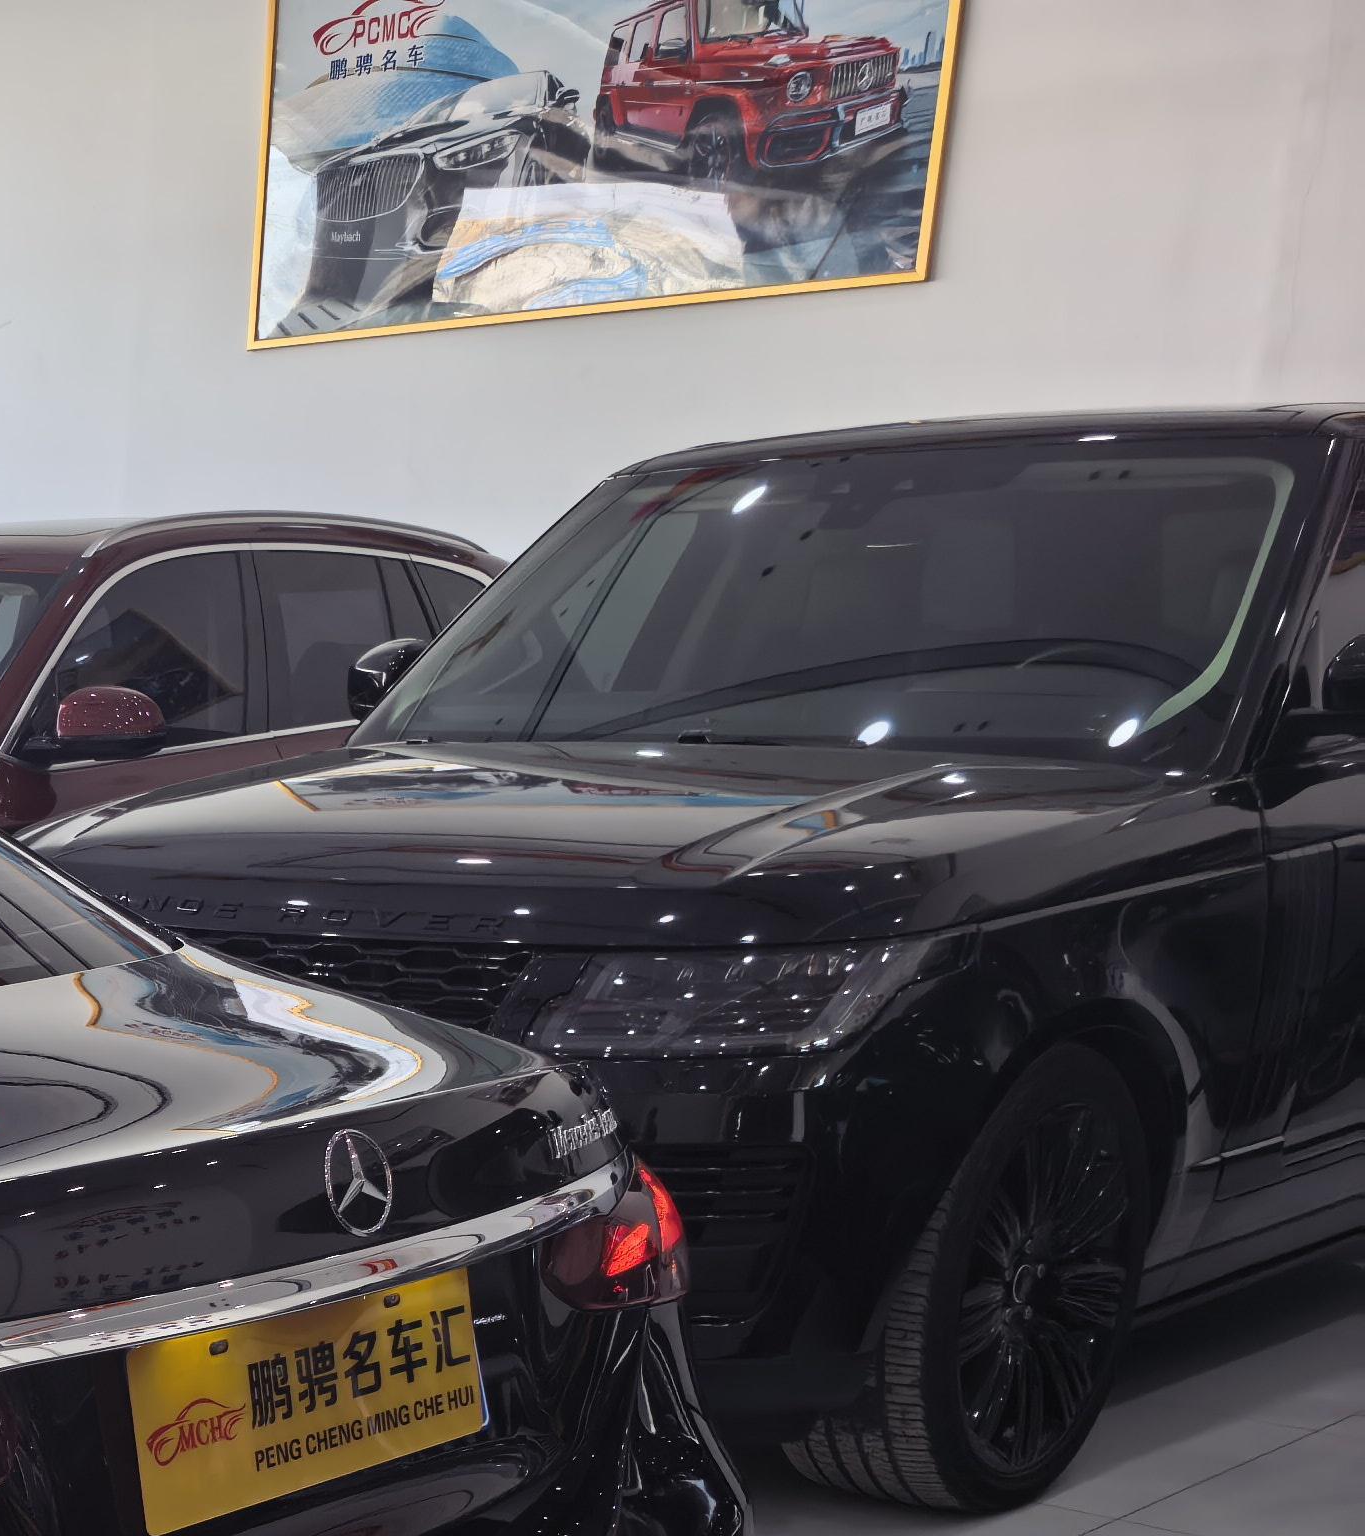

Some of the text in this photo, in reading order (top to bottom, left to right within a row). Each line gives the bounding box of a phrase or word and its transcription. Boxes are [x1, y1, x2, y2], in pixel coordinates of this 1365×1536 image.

[330, 44, 424, 80] 鹏骋名车
[277, 906, 505, 934] ROVER
[246, 1305, 471, 1431] 鹏骋名车汇
[254, 1384, 475, 1473] PENG CHENG MING CHE HUI
